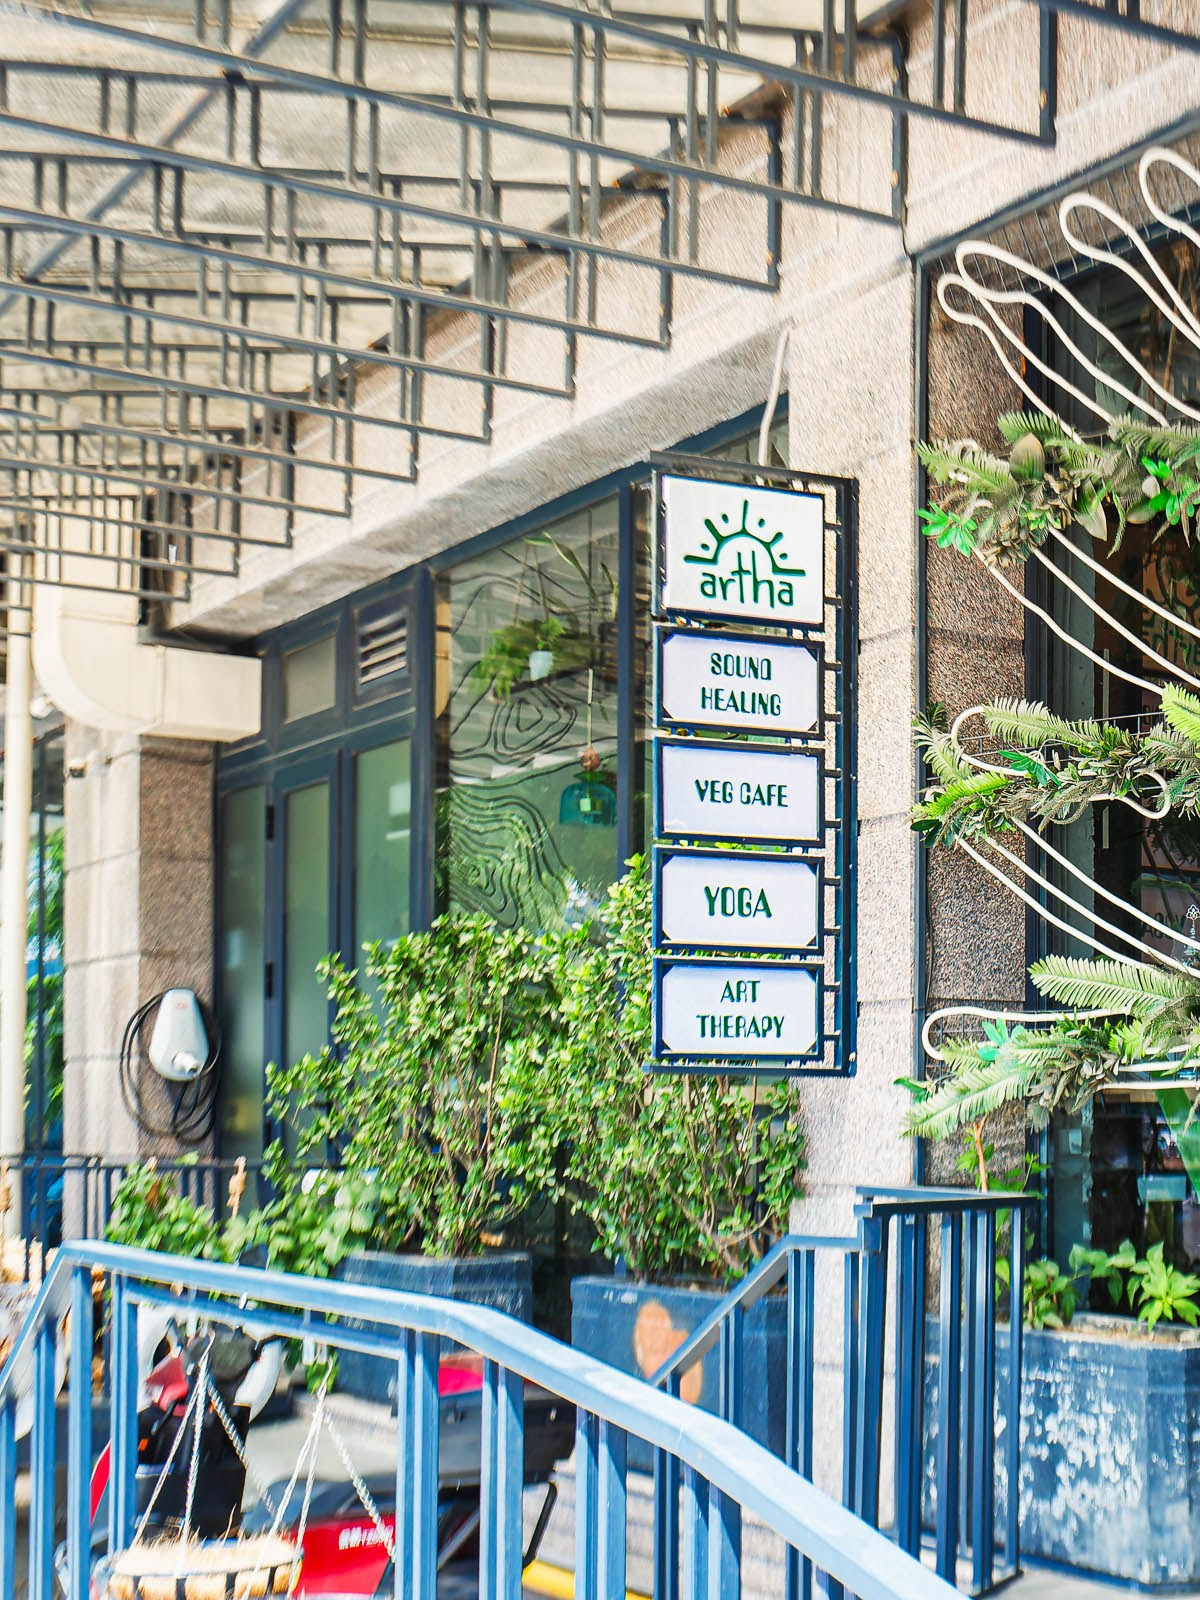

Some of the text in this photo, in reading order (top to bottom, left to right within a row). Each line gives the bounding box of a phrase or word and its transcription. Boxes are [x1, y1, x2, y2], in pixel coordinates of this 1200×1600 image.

[699, 550, 794, 608] artha
[710, 652, 772, 681] SOUND
[701, 686, 781, 717] HEALING
[695, 779, 789, 808] VEG CAFE
[704, 885, 773, 919] YOGA
[720, 979, 761, 1004] ART
[696, 1014, 785, 1039] THERAPY
